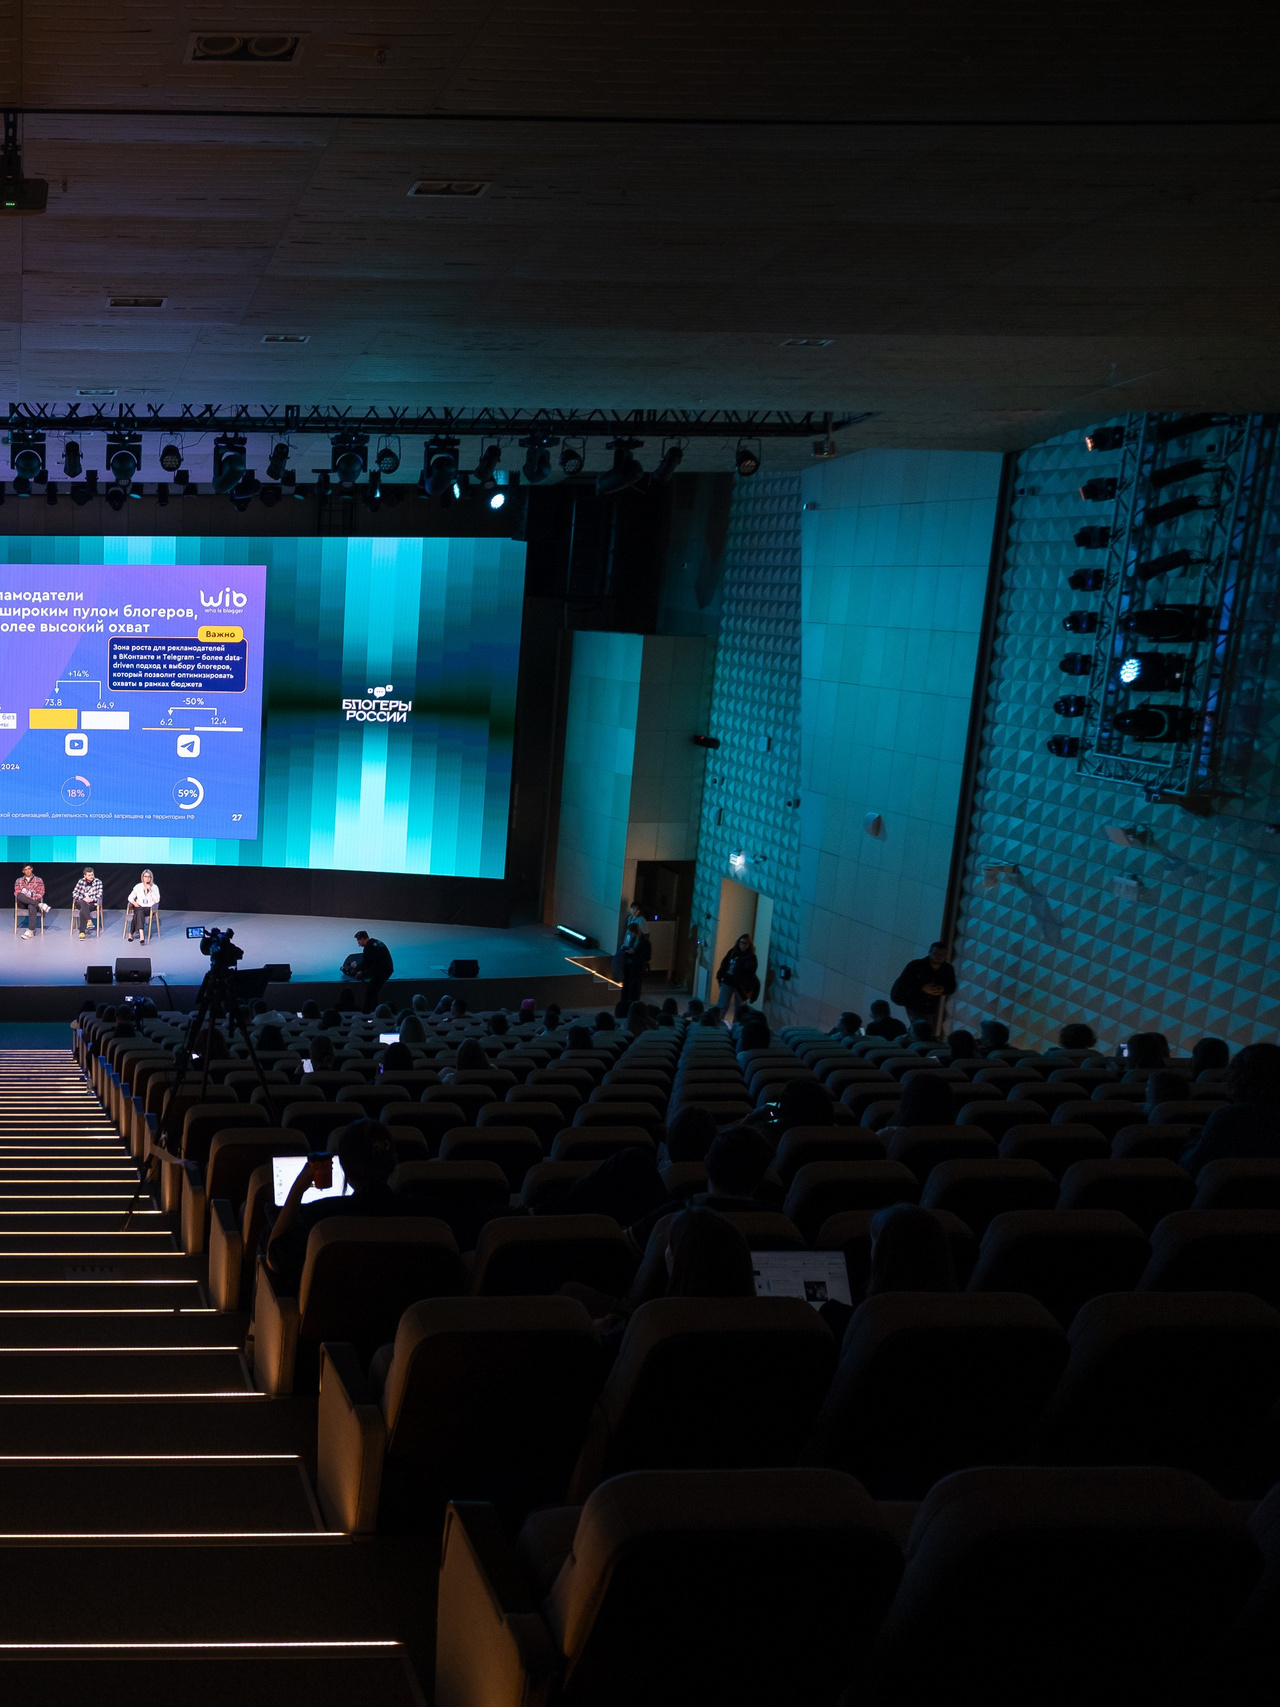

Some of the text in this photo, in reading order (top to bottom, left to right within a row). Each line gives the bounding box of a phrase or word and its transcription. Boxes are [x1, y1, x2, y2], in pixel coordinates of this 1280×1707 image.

[0, 605, 70, 619] широким
[74, 608, 119, 620] пулом
[124, 605, 198, 620] блогеров,
[40, 619, 104, 632] высокий
[108, 623, 150, 633] охват
[45, 699, 62, 707] 73.8
[342, 699, 412, 711] БЛОГЕРЫ
[346, 711, 407, 722] РОССИИ
[67, 789, 85, 798] 18%
[178, 789, 197, 798] 59%
